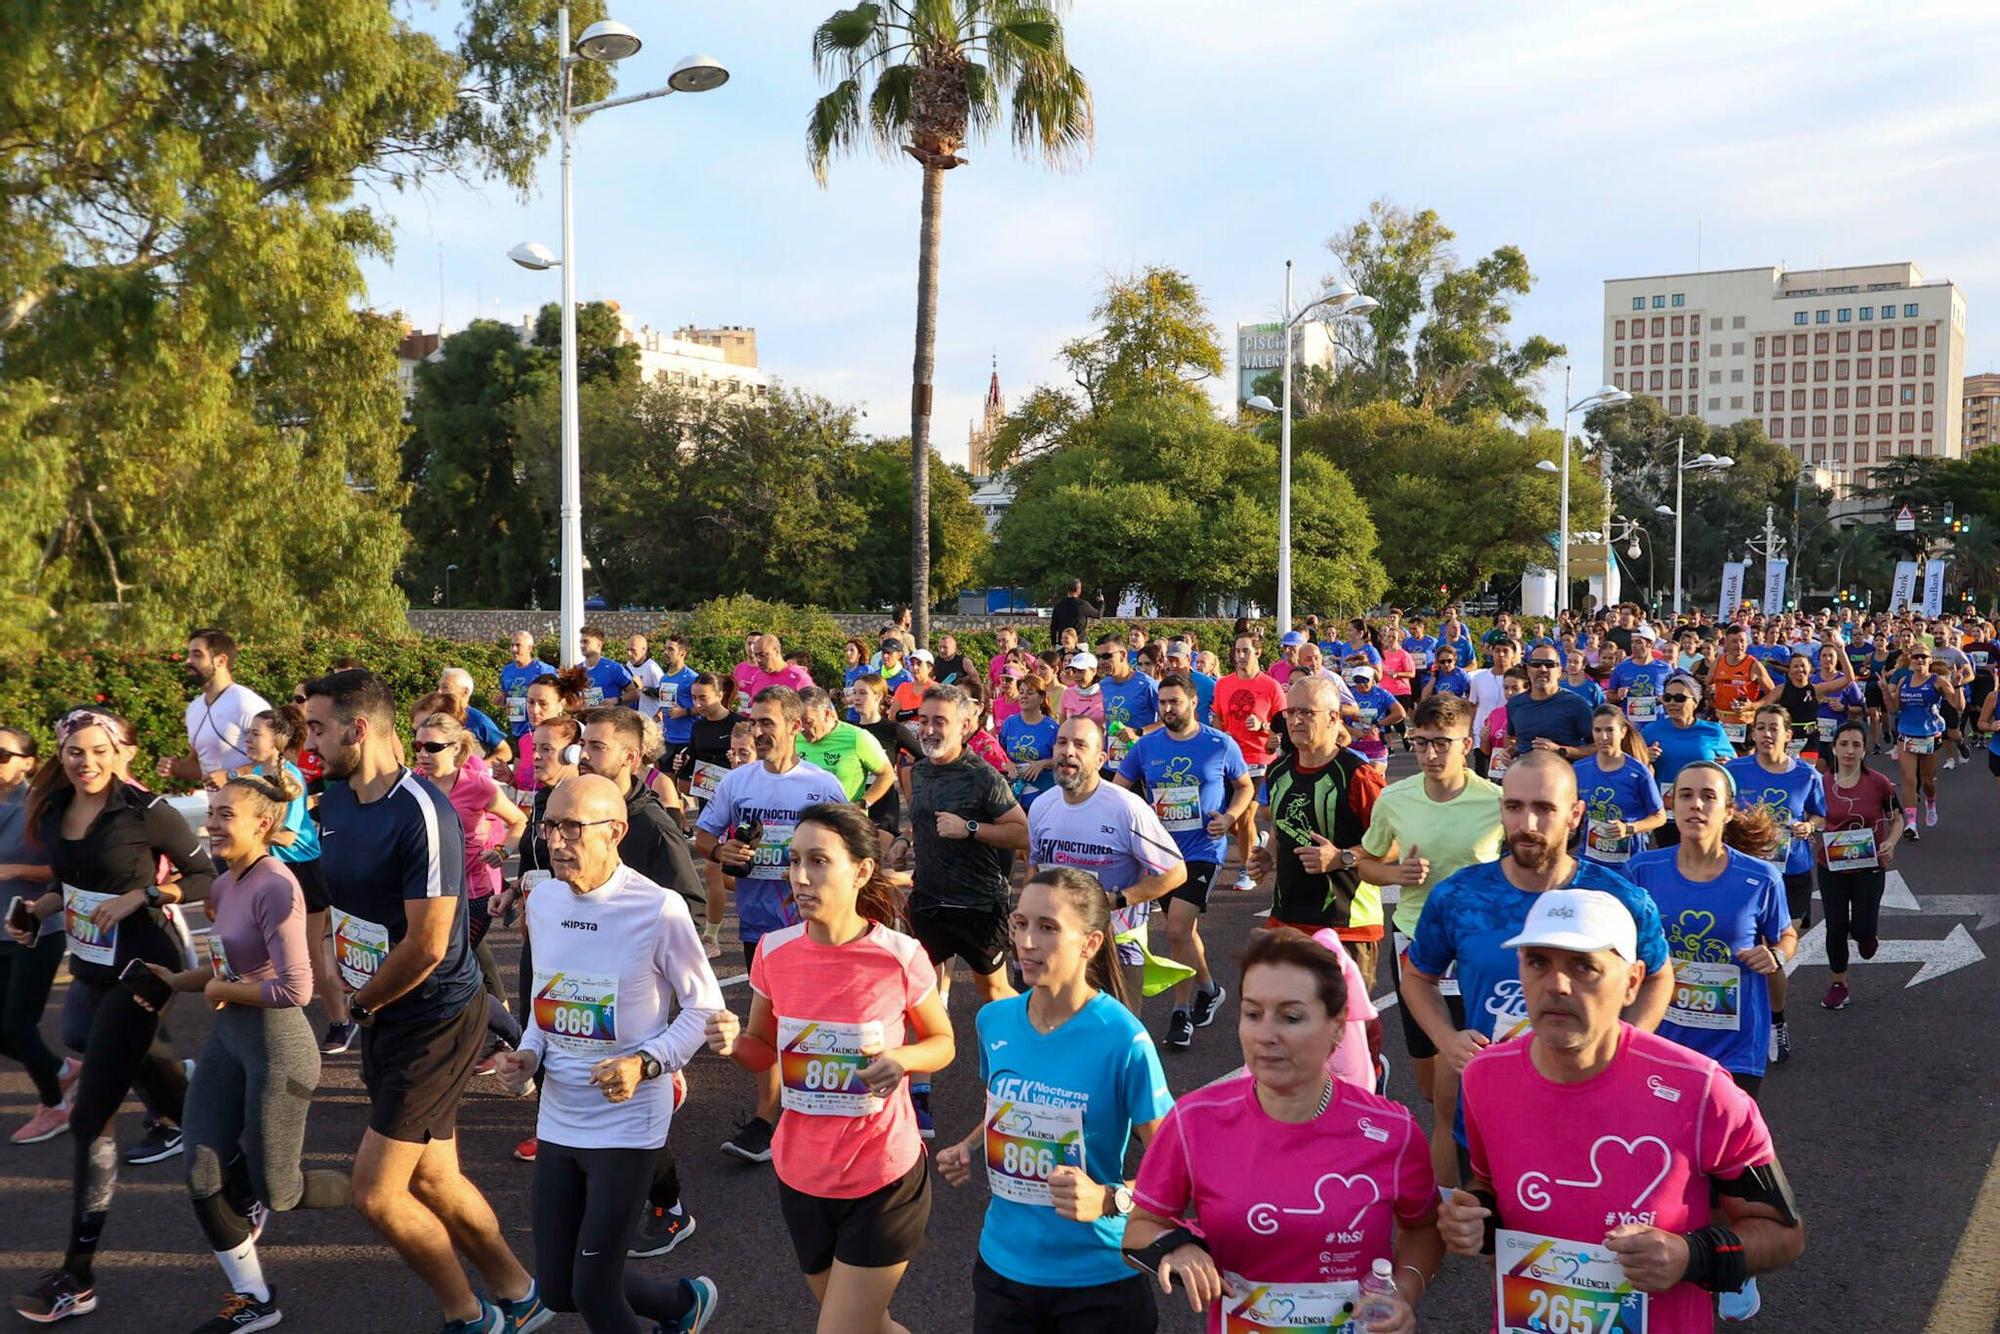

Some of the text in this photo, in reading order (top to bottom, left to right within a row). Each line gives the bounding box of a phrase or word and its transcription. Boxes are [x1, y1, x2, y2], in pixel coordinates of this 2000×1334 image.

[1245, 335, 1287, 351] PISCIN
[1162, 805, 1192, 820] 2069
[754, 848, 783, 866] 650
[343, 942, 379, 975] 3801
[1676, 987, 1718, 1012] 929
[554, 1006, 595, 1036] 869
[804, 1059, 857, 1092] 867
[1032, 1081, 1090, 1102] Nocturna
[1003, 1142, 1054, 1180] 866
[1527, 1289, 1620, 1334] 2657
